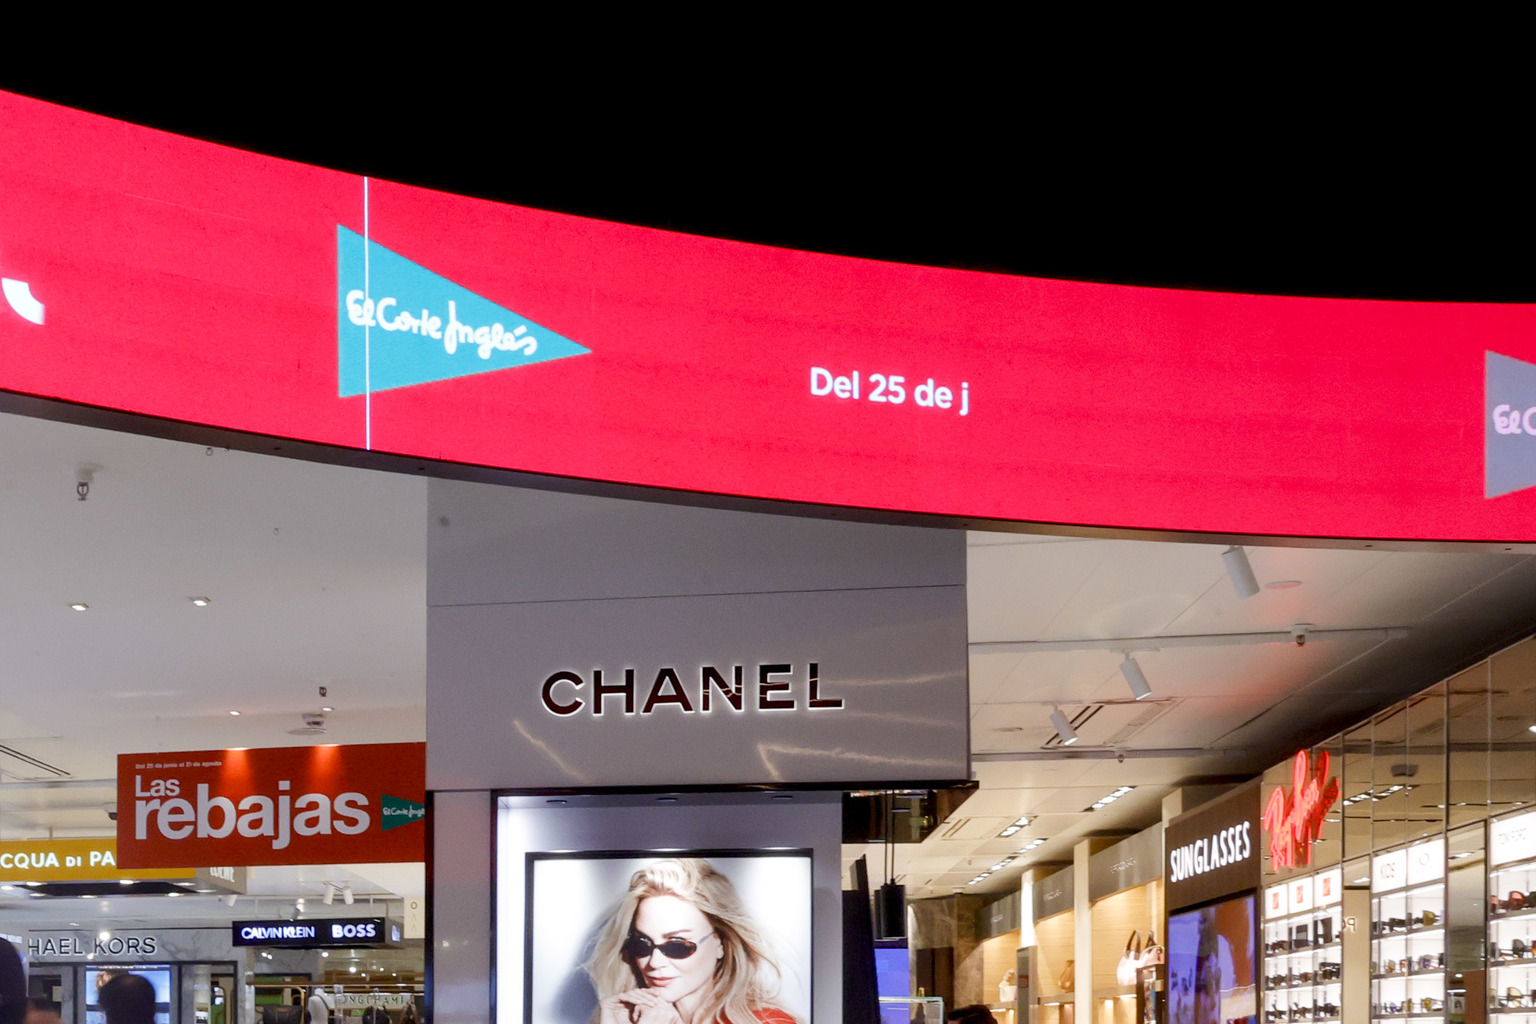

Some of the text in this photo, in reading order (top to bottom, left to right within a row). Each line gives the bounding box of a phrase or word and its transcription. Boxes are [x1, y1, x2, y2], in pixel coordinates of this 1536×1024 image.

[376, 297, 442, 340] Corte
[444, 300, 538, 360] Inglés
[811, 367, 860, 400] Del
[868, 374, 906, 404] 25
[914, 378, 954, 409] de
[541, 661, 845, 717] CHANEL
[135, 774, 181, 798] Las
[134, 780, 372, 850] rebajas
[65, 855, 83, 867] DI
[1170, 820, 1251, 884] SUNGLASSES
[93, 936, 157, 956] KORS
[241, 926, 316, 940] CALVIN KLEIN
[331, 923, 376, 938] BOSS
